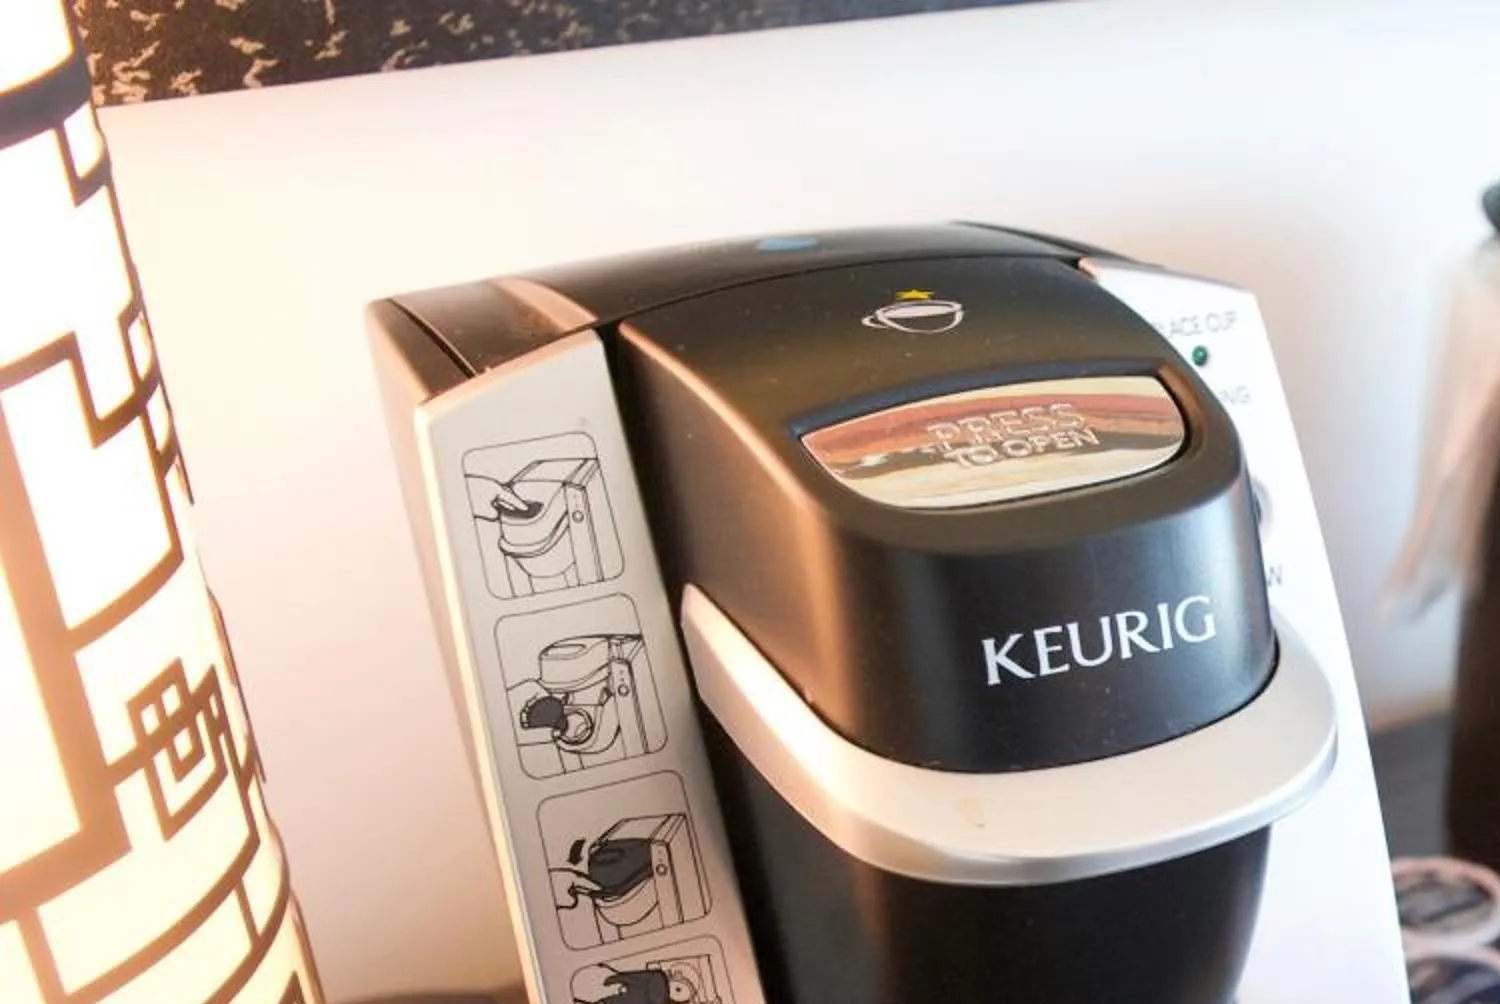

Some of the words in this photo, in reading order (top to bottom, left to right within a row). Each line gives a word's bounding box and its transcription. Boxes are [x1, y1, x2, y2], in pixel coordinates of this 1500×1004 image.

[1205, 310, 1238, 333] CUP
[926, 402, 1085, 451] PRESS
[943, 443, 1000, 467] TO
[1001, 428, 1101, 458] OPEN
[981, 595, 1217, 686] KEURIG
